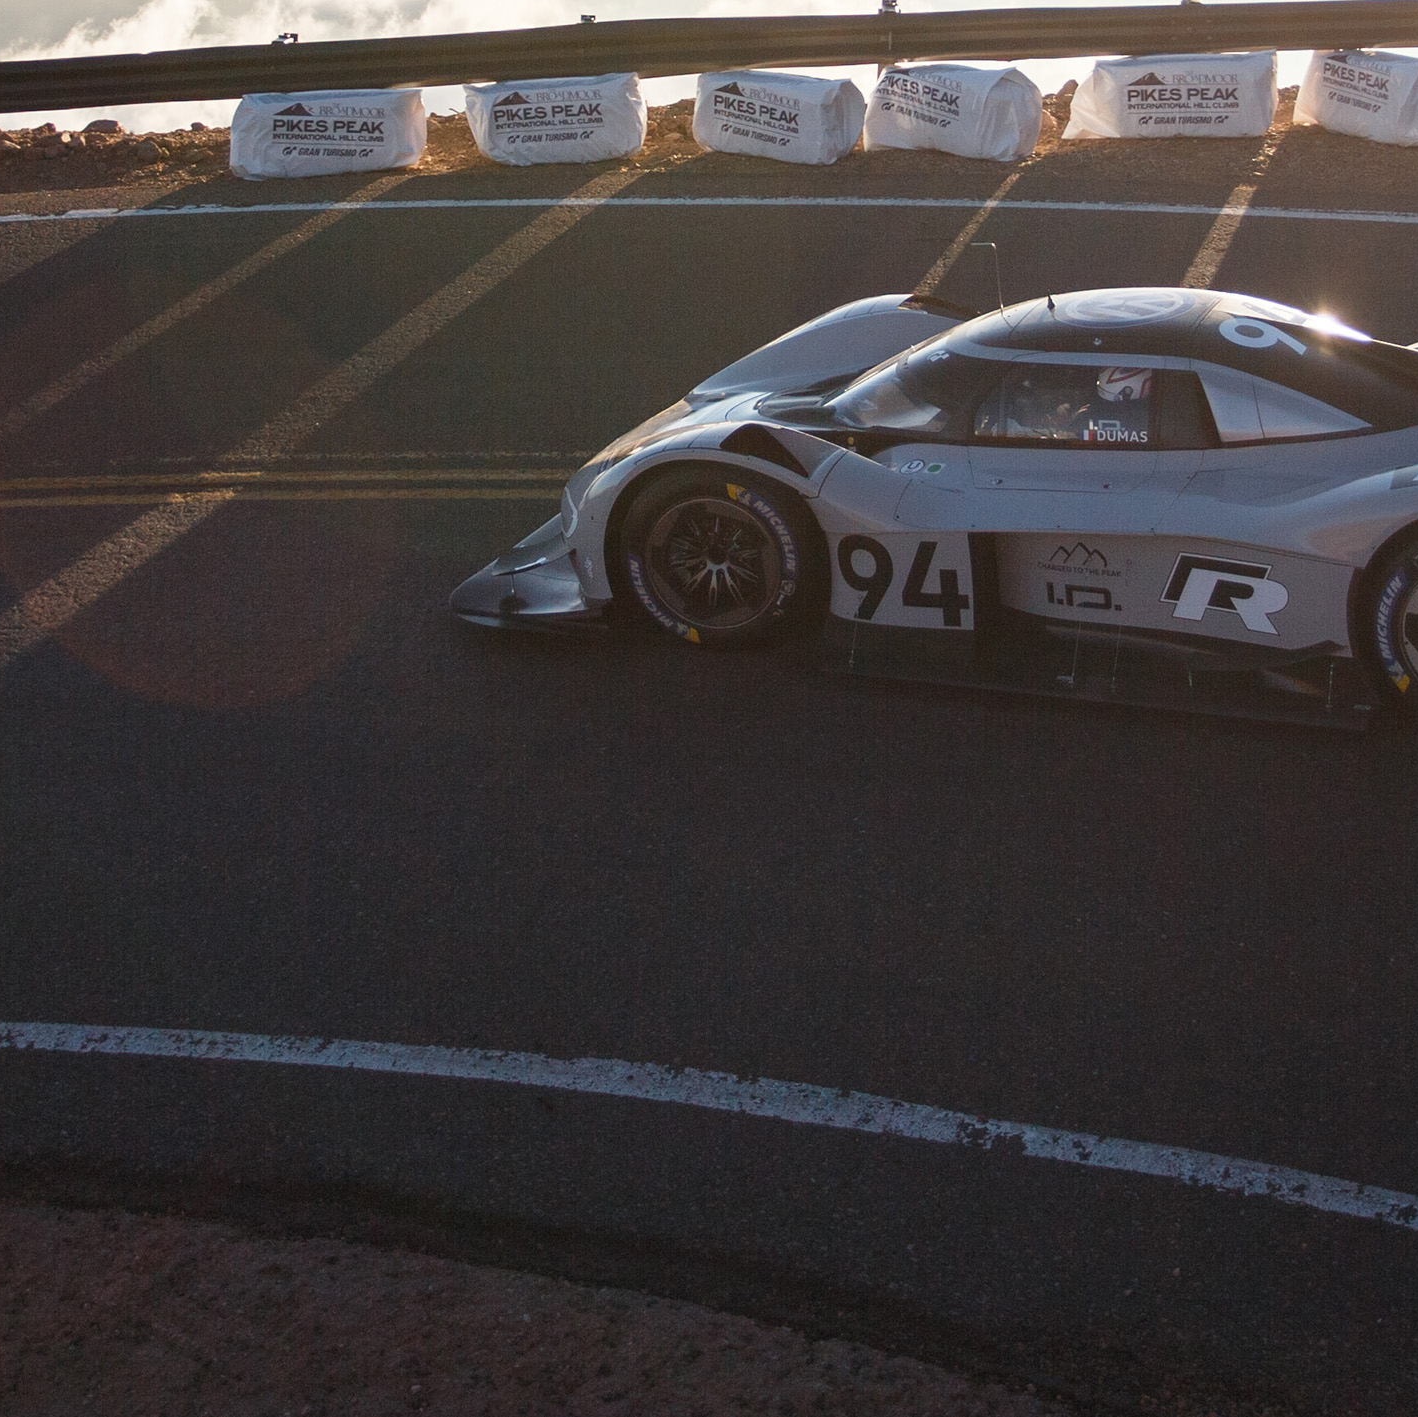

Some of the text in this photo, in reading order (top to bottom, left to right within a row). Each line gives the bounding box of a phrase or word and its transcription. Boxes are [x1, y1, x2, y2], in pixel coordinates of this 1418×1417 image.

[1323, 62, 1355, 82] PIKES
[1358, 71, 1389, 92] PEAK
[878, 76, 959, 109] PIKES PEAK
[1127, 87, 1238, 102] PIKES PEAK
[493, 103, 602, 122] PIKES PEAK
[714, 95, 799, 126] PIKES PEAK
[1128, 102, 1191, 110] INTERNATIONAL
[273, 119, 384, 134] PIKES PEAK
[496, 120, 557, 130] INTERNATIONAL
[714, 109, 799, 134] INTERNATIONAL HILL CLIMB
[1154, 116, 1211, 125] GRAN TURISMO
[358, 135, 384, 143] CLIMB
[522, 132, 577, 143] GRAN TURISMO
[732, 127, 777, 144] GRAN TURISMO
[298, 147, 357, 157] GRAN TURISMO
[1097, 431, 1148, 442] DUMAS
[753, 500, 796, 571] MICHELIN
[1037, 562, 1072, 573] CHARGED
[1101, 569, 1122, 577] PEAK
[837, 533, 970, 627] 94
[630, 559, 674, 627] MICHELIN
[1171, 567, 1289, 636] R
[1376, 575, 1402, 659] MICHELIN
